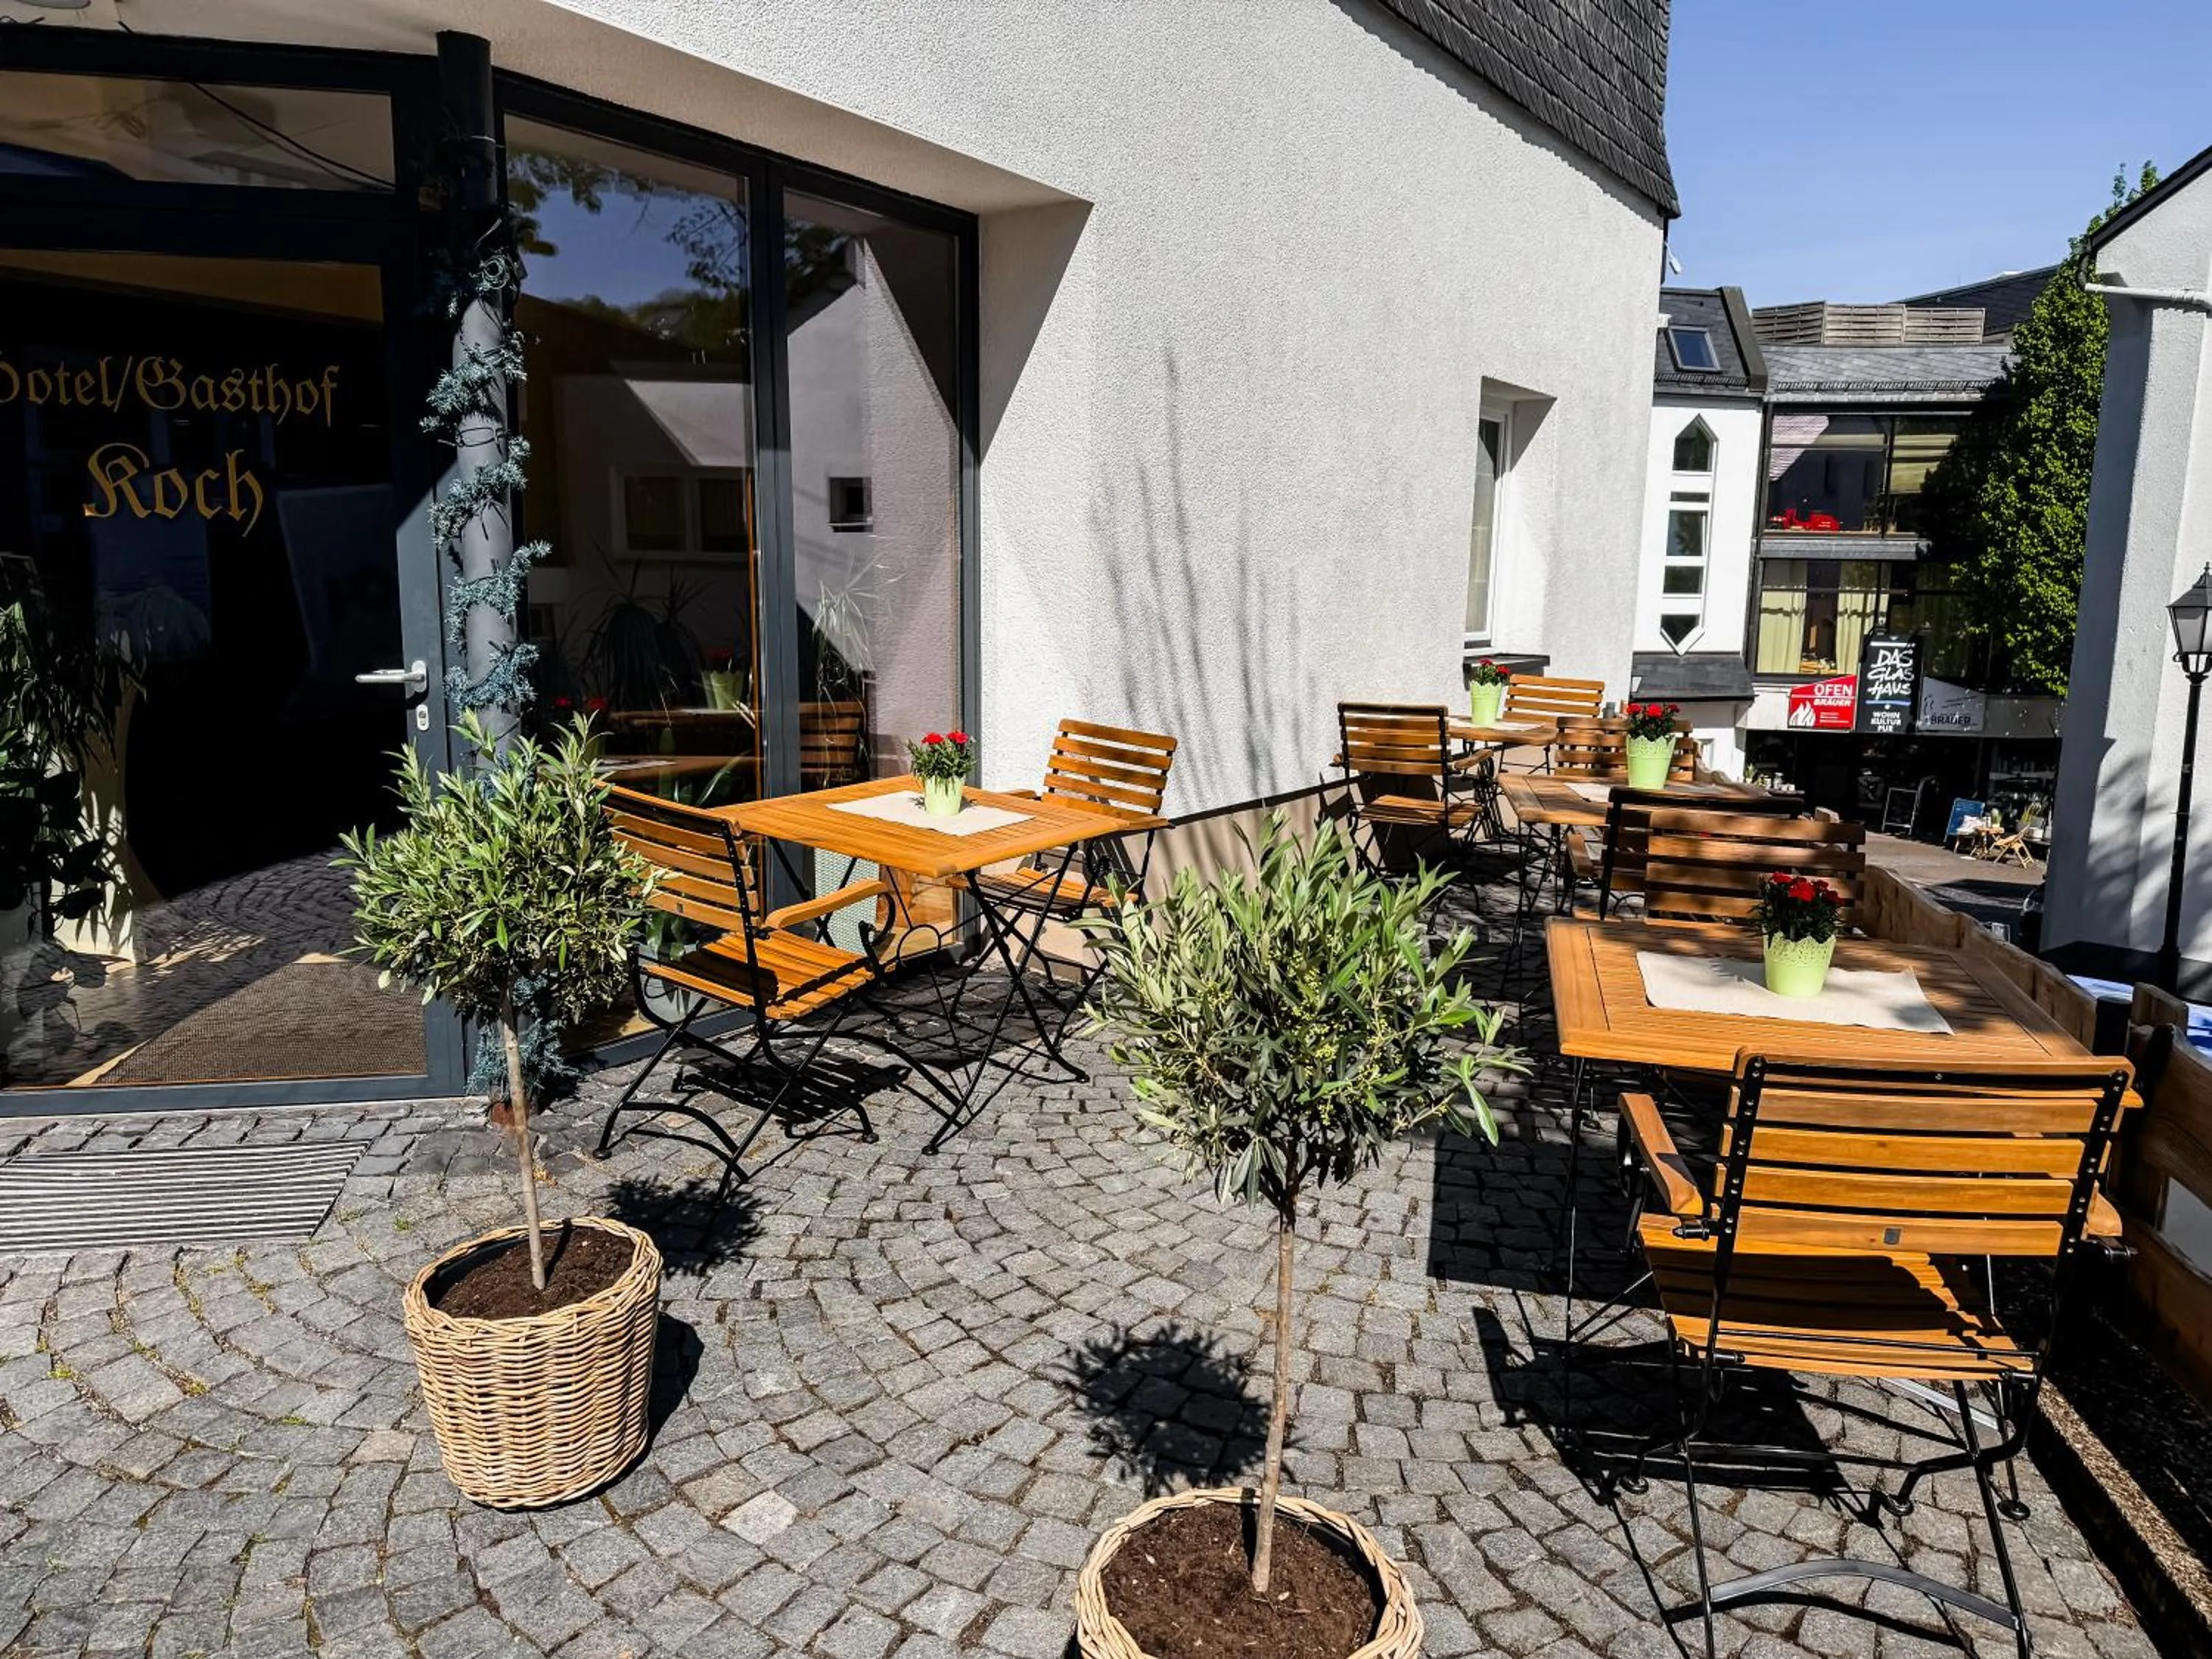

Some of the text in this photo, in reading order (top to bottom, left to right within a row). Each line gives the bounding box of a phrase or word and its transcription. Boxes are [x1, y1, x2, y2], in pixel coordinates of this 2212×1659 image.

[83, 443, 263, 537] Koch
[1871, 648, 1913, 668] DAS
[1867, 667, 1915, 681] GLAS
[1815, 684, 1853, 696] OFEN
[1867, 680, 1911, 700] HAUS
